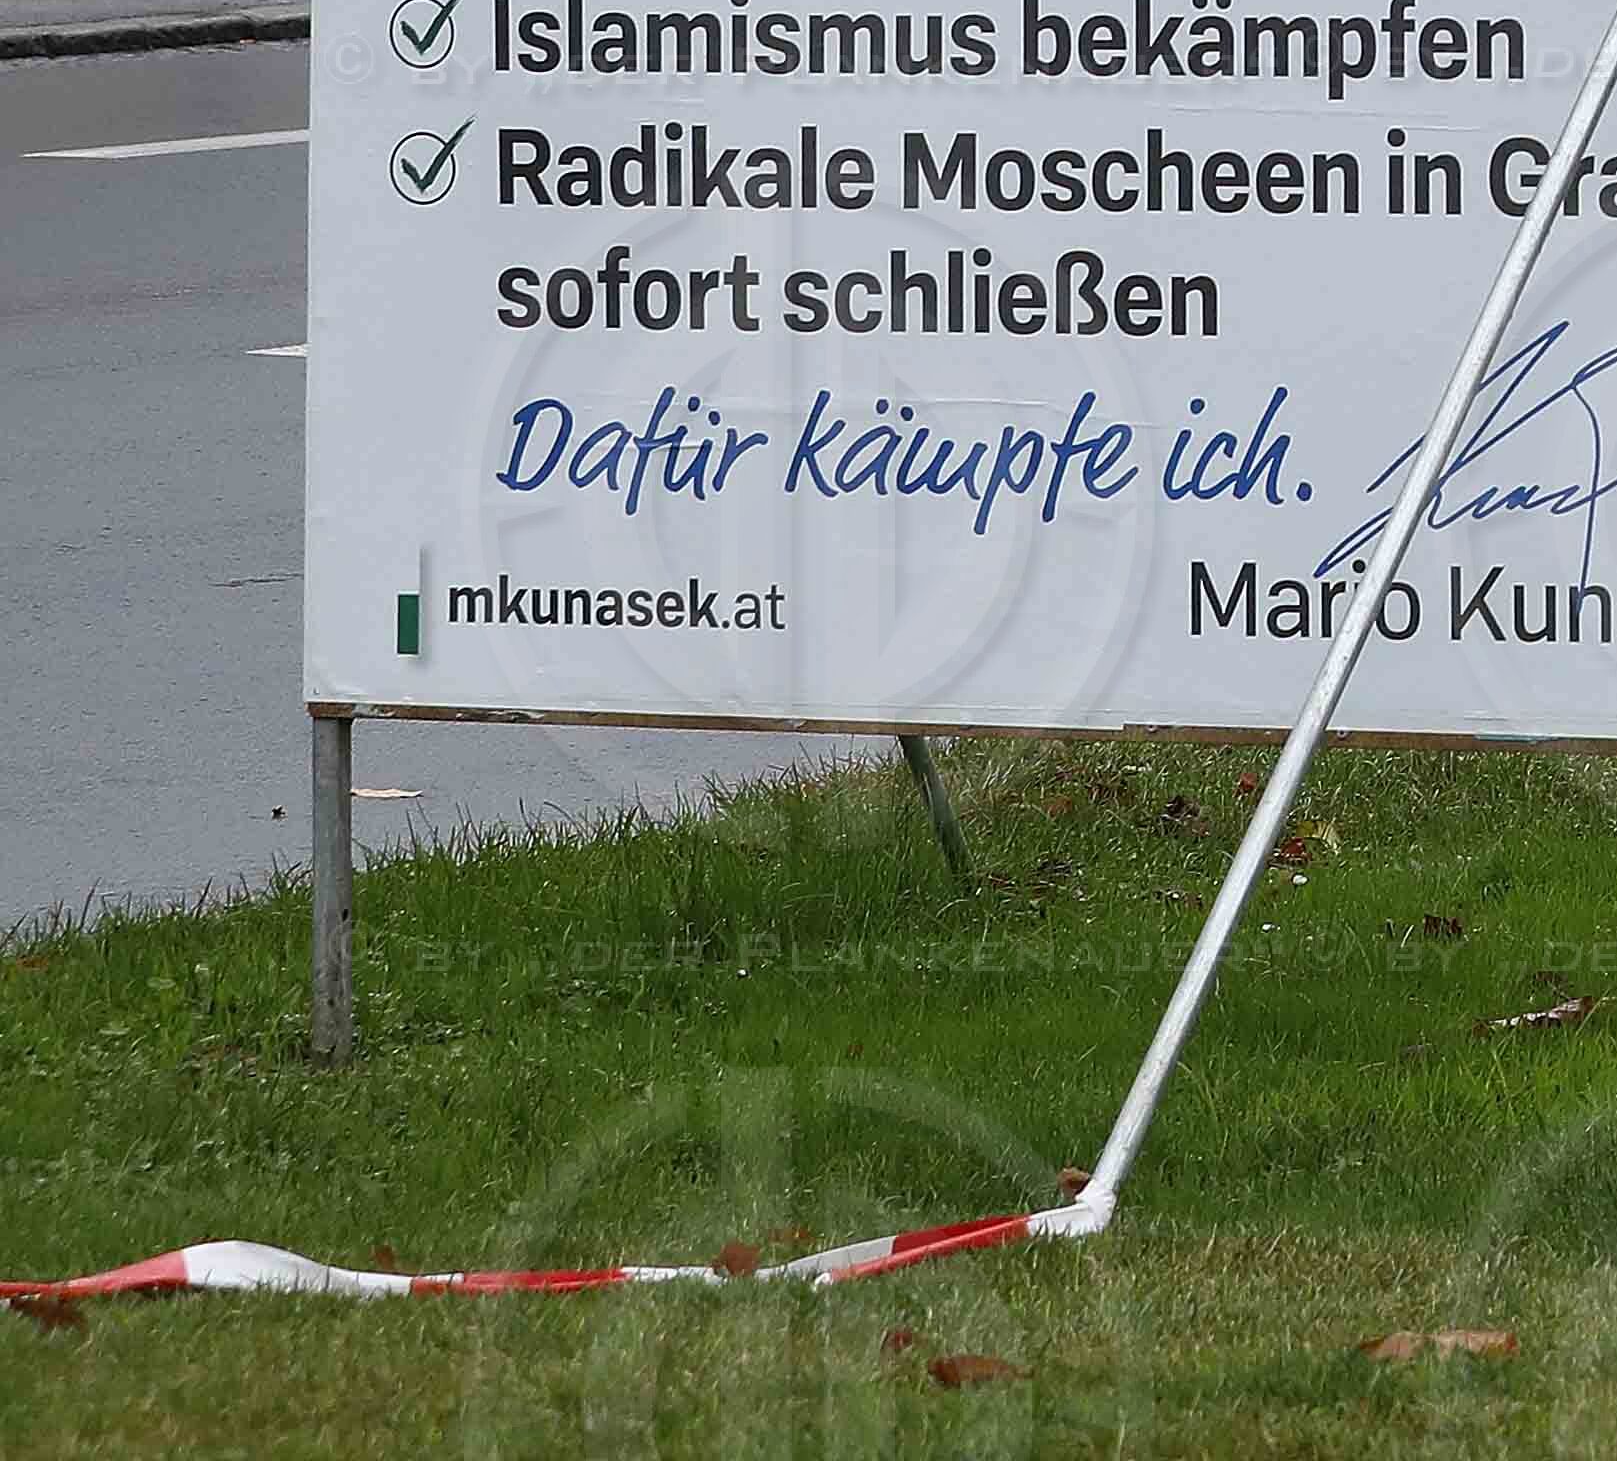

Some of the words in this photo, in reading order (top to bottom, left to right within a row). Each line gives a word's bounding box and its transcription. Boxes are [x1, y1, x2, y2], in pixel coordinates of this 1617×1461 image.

[498, 121, 876, 213] Radikale
[902, 127, 1361, 216] Moscheen
[1387, 128, 1463, 216] in
[497, 245, 760, 334] sofort
[783, 247, 1219, 338] schließen
[495, 386, 770, 516] Dafür
[784, 390, 1141, 536] kämpfe
[1162, 386, 1315, 506] ich.
[446, 574, 787, 632] mkunasek.at
